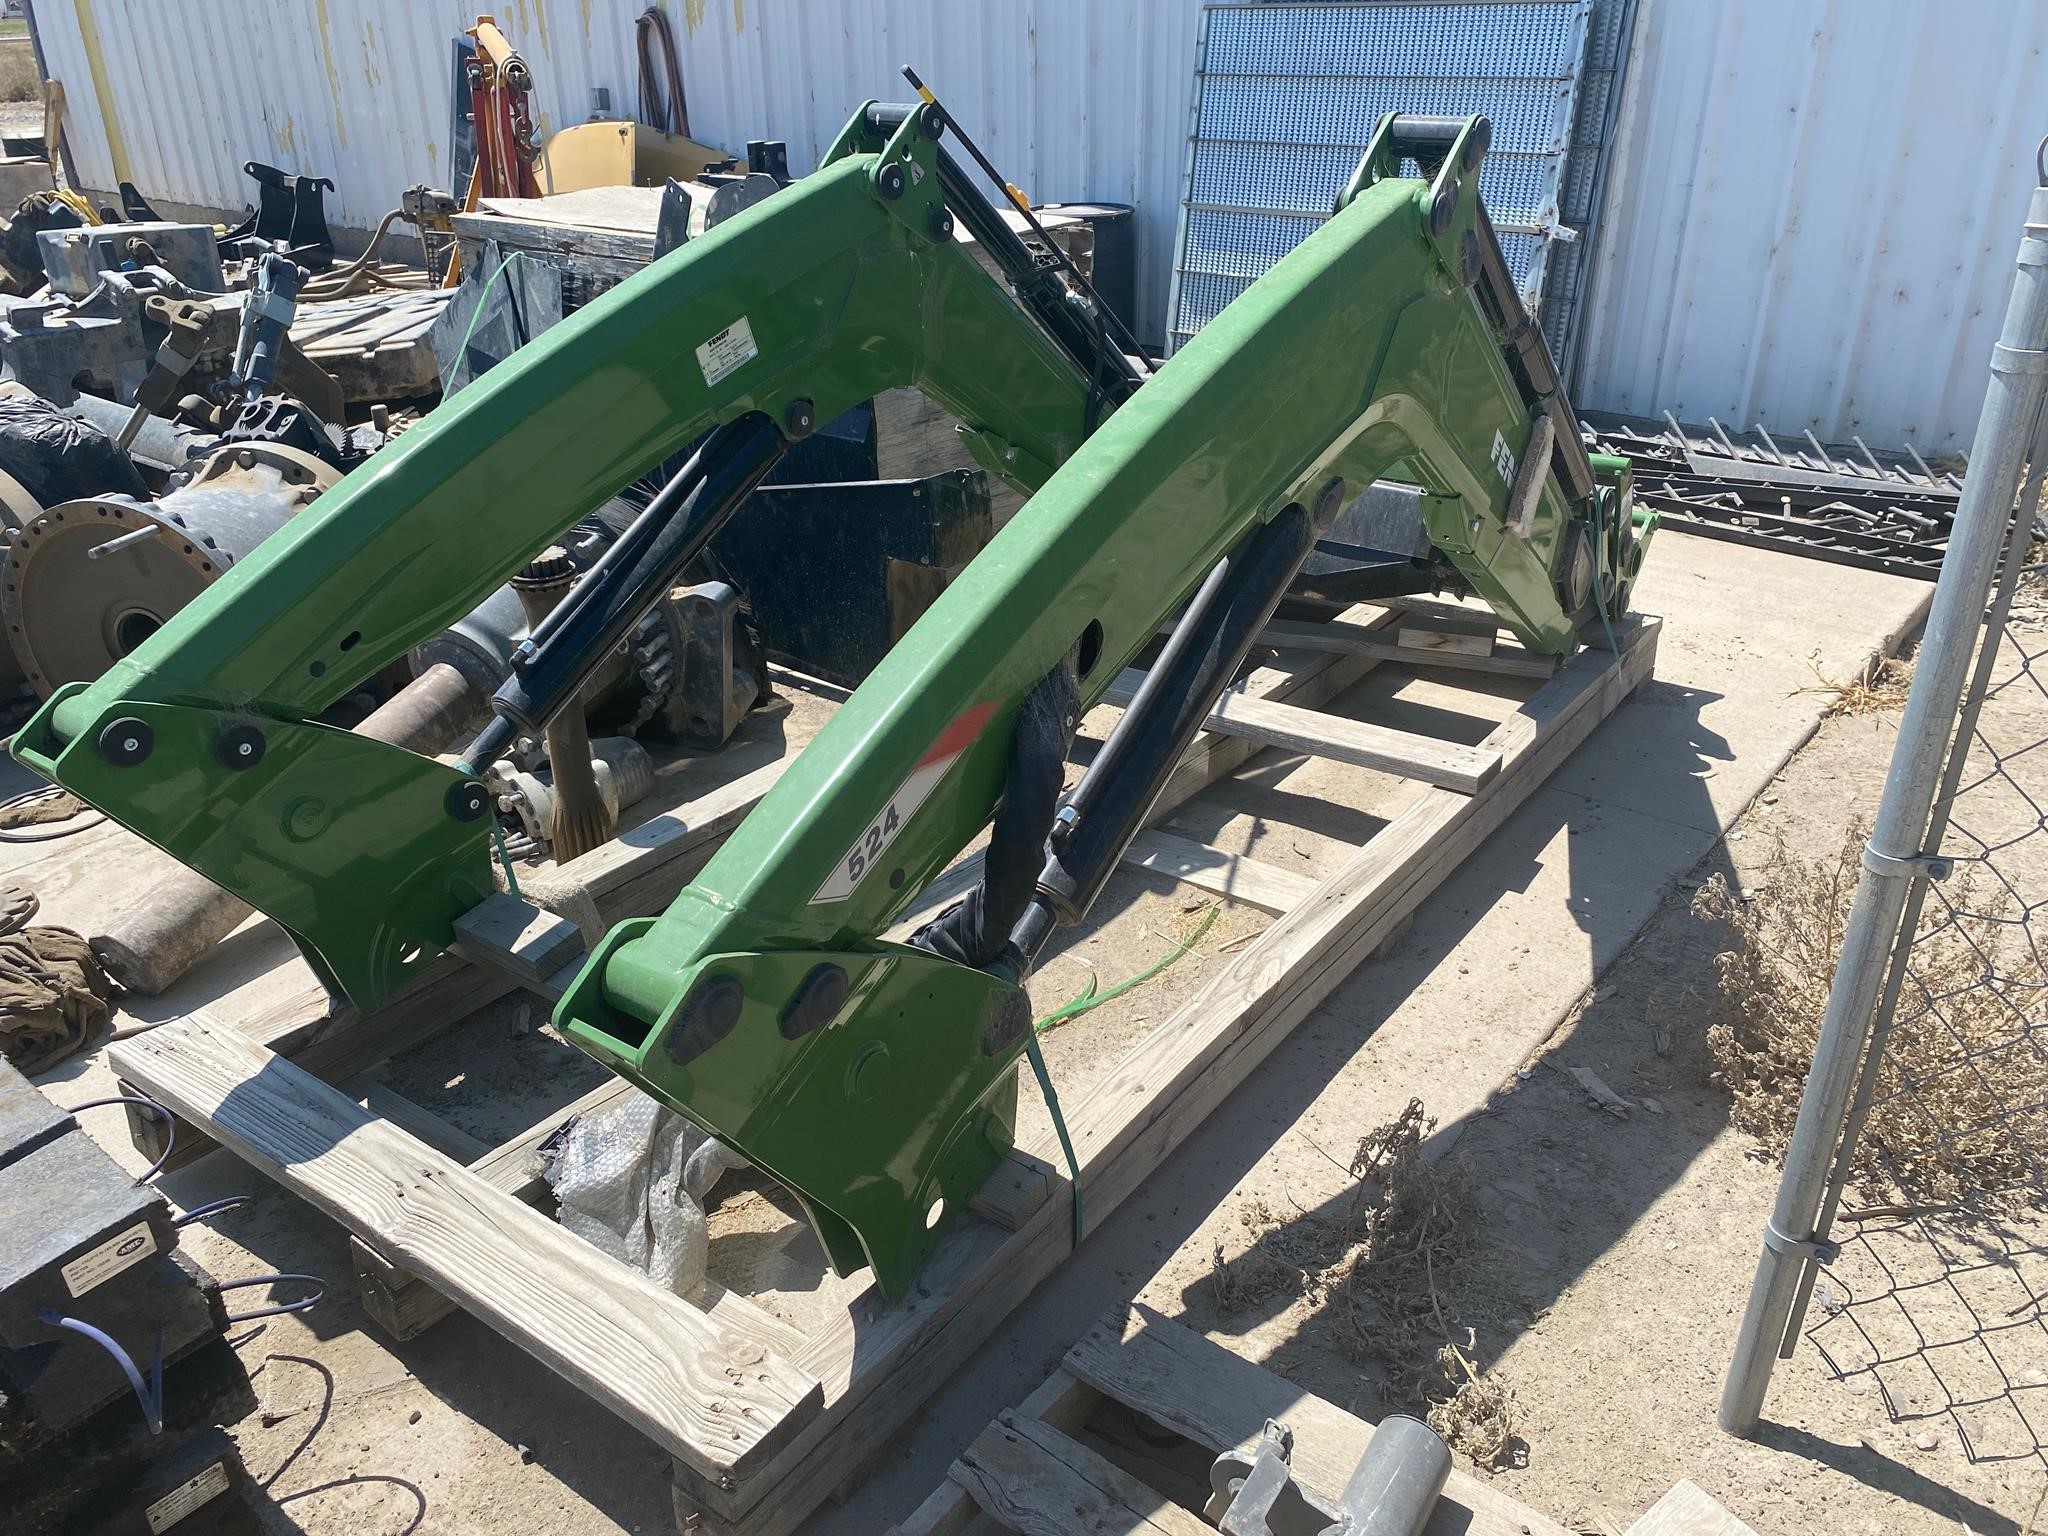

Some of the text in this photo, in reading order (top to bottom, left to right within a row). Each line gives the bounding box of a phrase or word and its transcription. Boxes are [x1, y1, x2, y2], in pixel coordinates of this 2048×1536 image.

[707, 328, 730, 348] FENDT
[1490, 428, 1519, 491] FEN
[848, 802, 900, 882] 524
